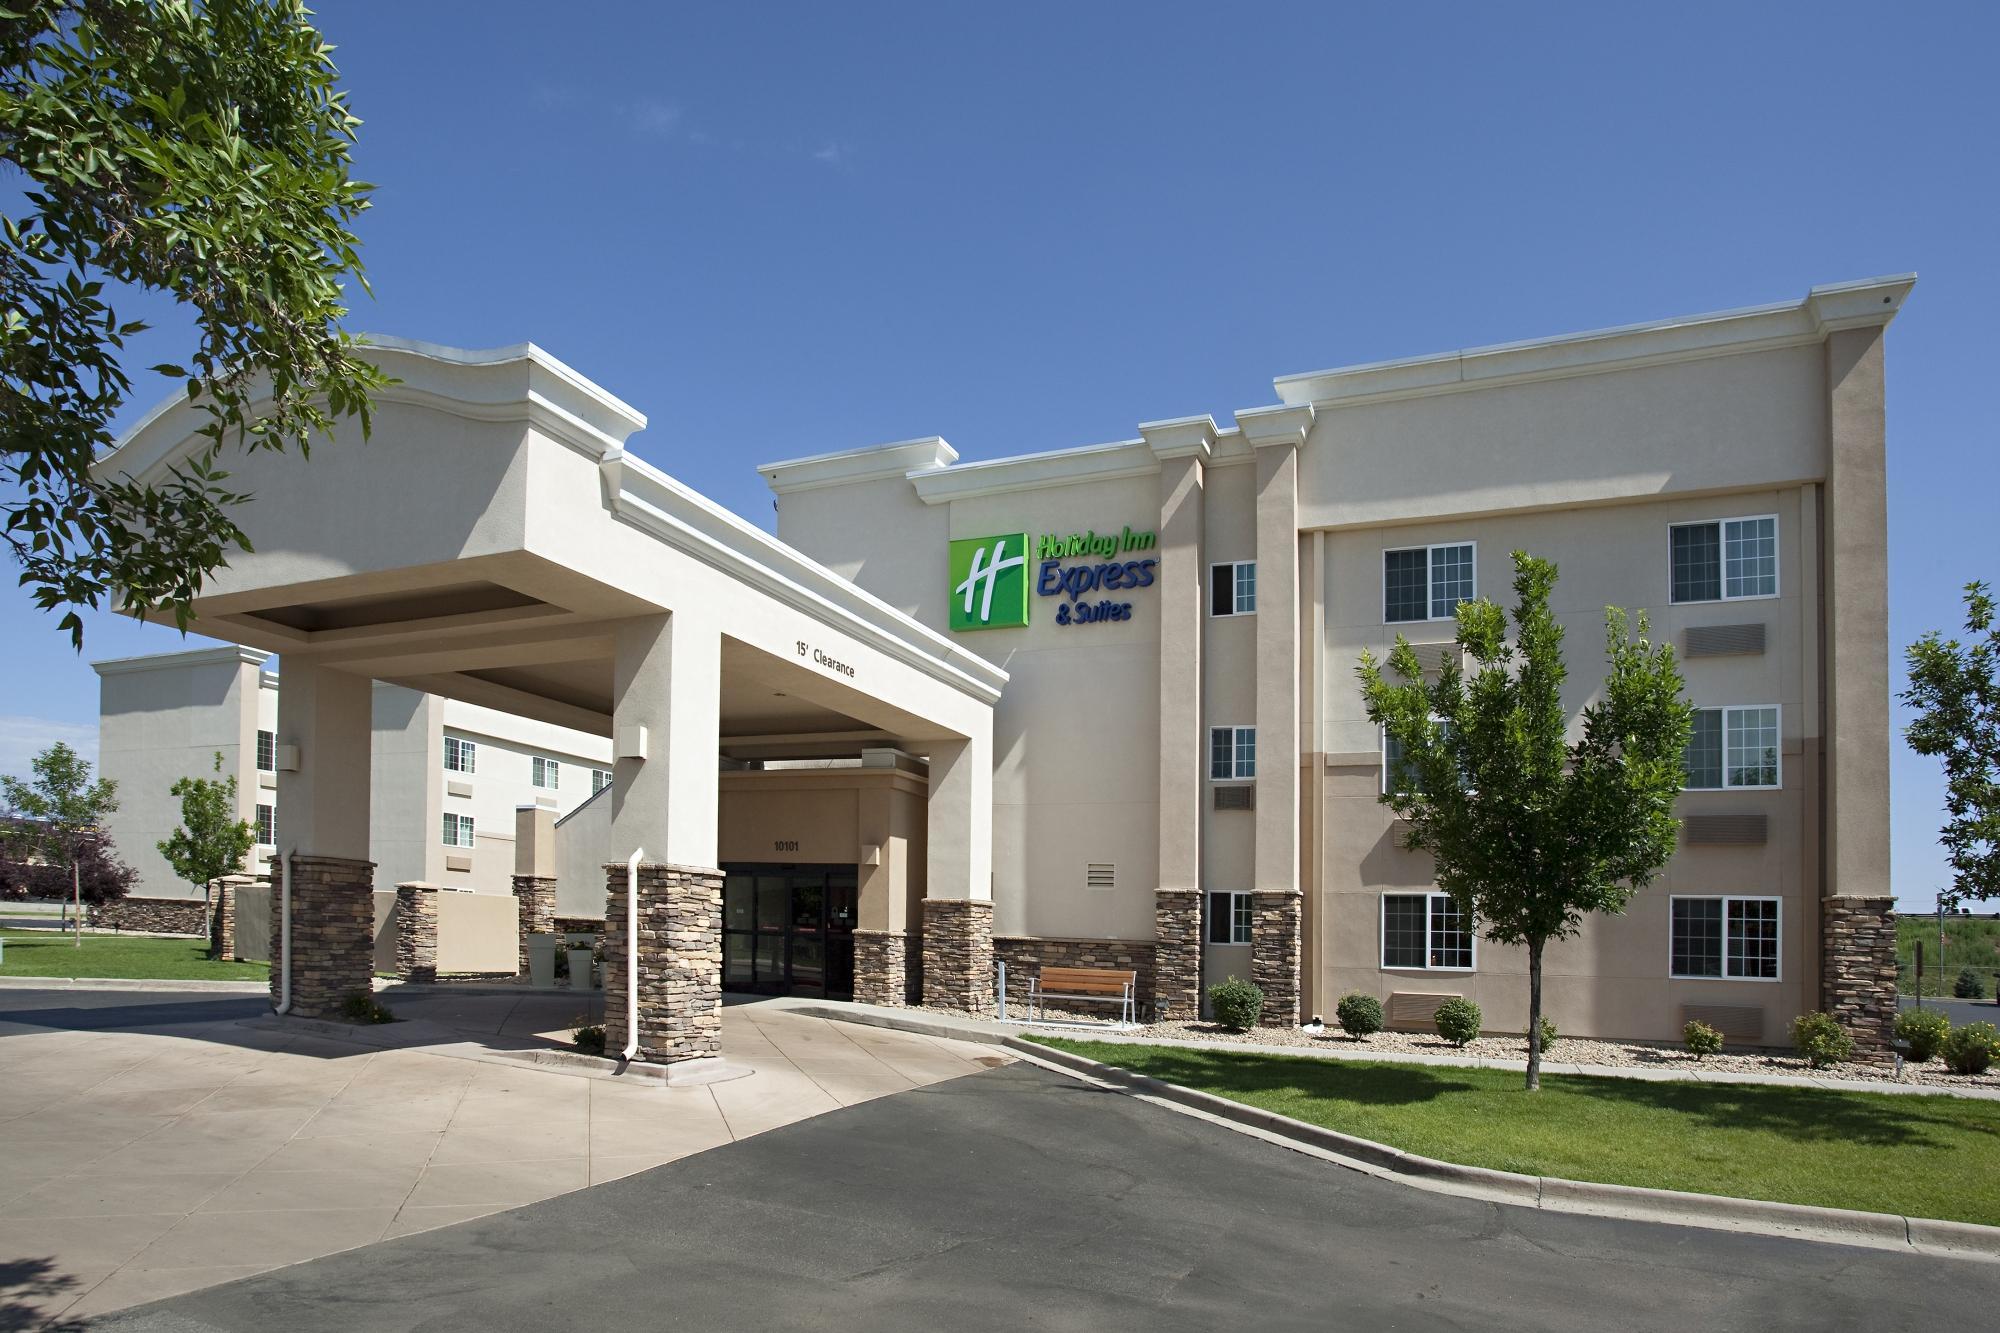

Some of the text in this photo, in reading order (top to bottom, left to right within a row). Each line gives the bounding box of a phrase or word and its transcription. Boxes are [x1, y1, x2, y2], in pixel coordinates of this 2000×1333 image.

[1036, 525, 1156, 560] Holiday Inn
[1036, 559, 1156, 603] Express
[1055, 600, 1132, 625] & Suites
[796, 640, 855, 678] 15' Clearance
[774, 840, 799, 851] 10101
